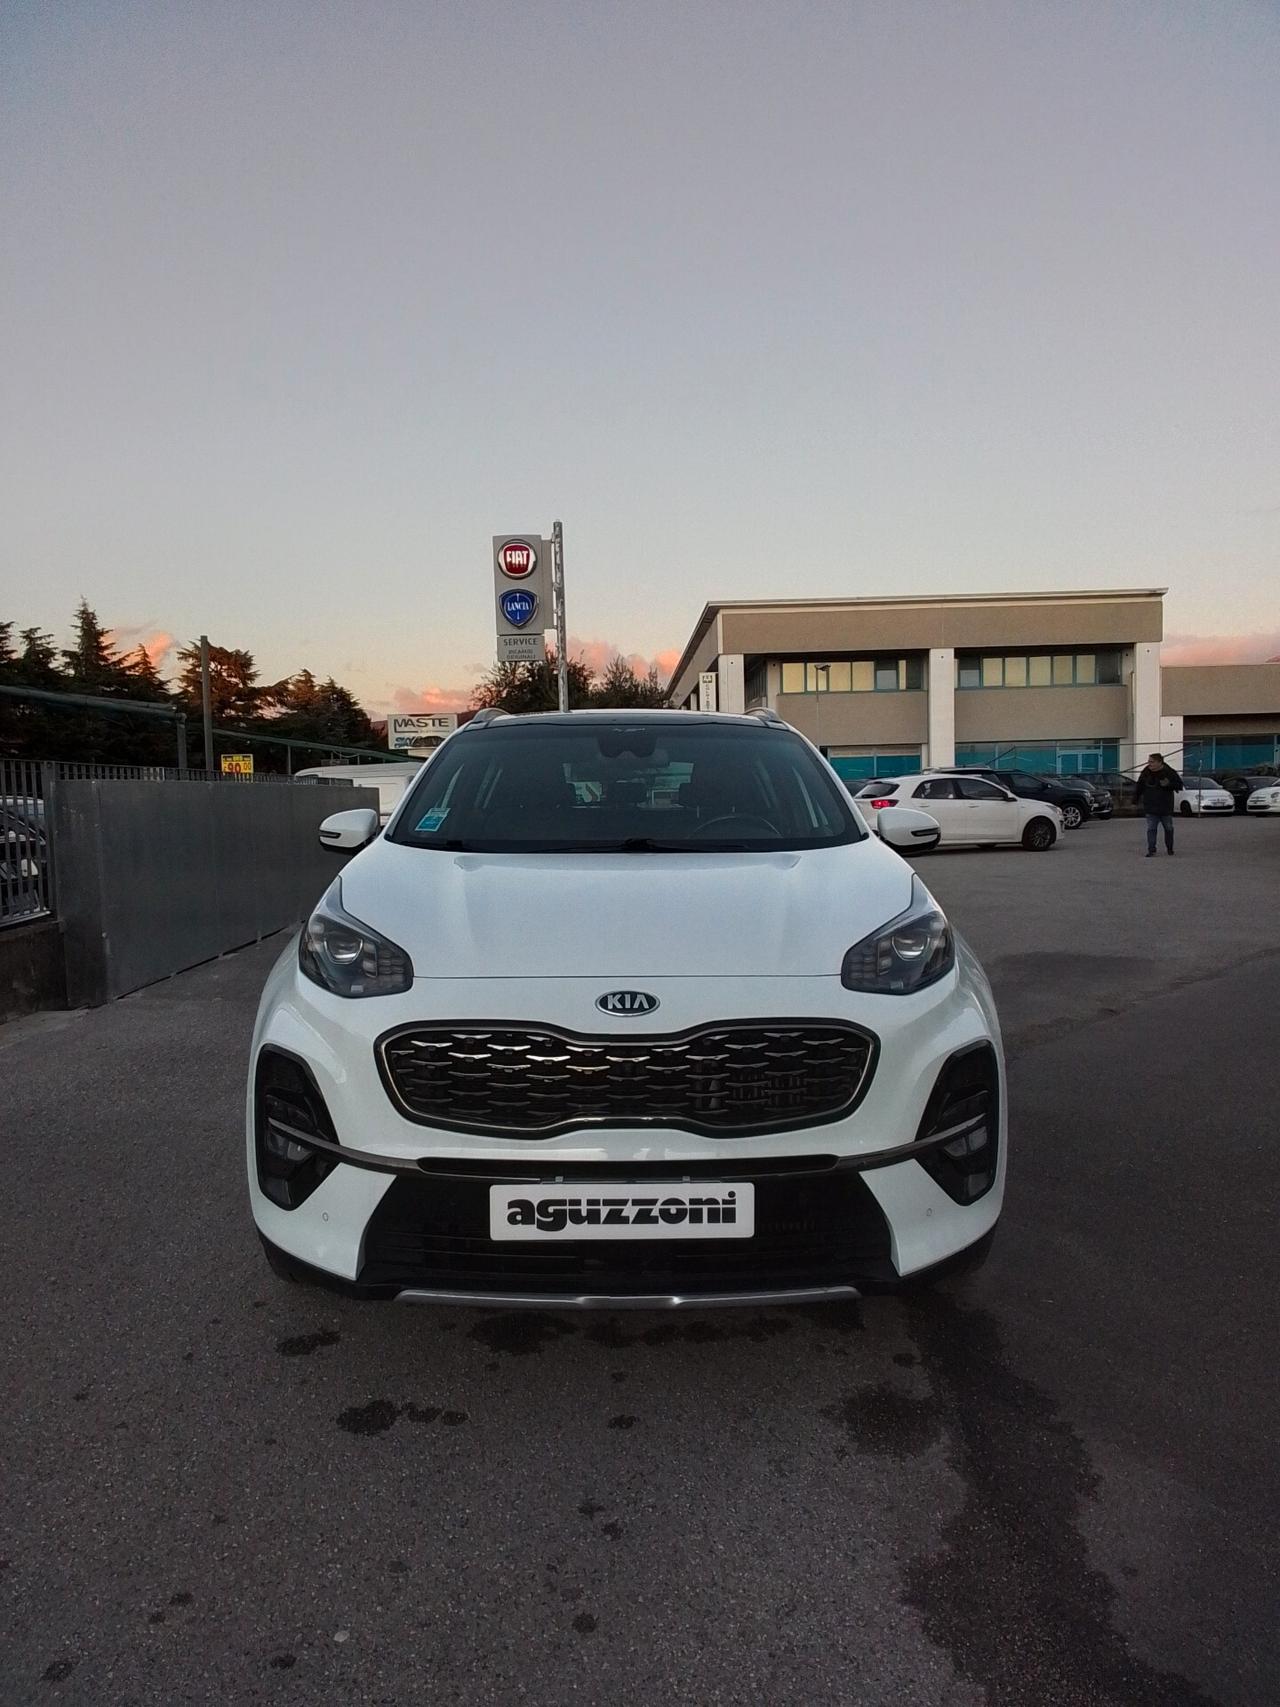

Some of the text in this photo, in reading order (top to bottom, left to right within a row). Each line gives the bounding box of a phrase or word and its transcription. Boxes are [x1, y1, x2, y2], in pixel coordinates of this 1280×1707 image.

[506, 550, 529, 565] FIAT
[507, 601, 529, 611] LANCIA
[503, 638, 538, 646] SERVICE
[607, 993, 650, 1010] KIA
[506, 1190, 737, 1232] aguzzoni
